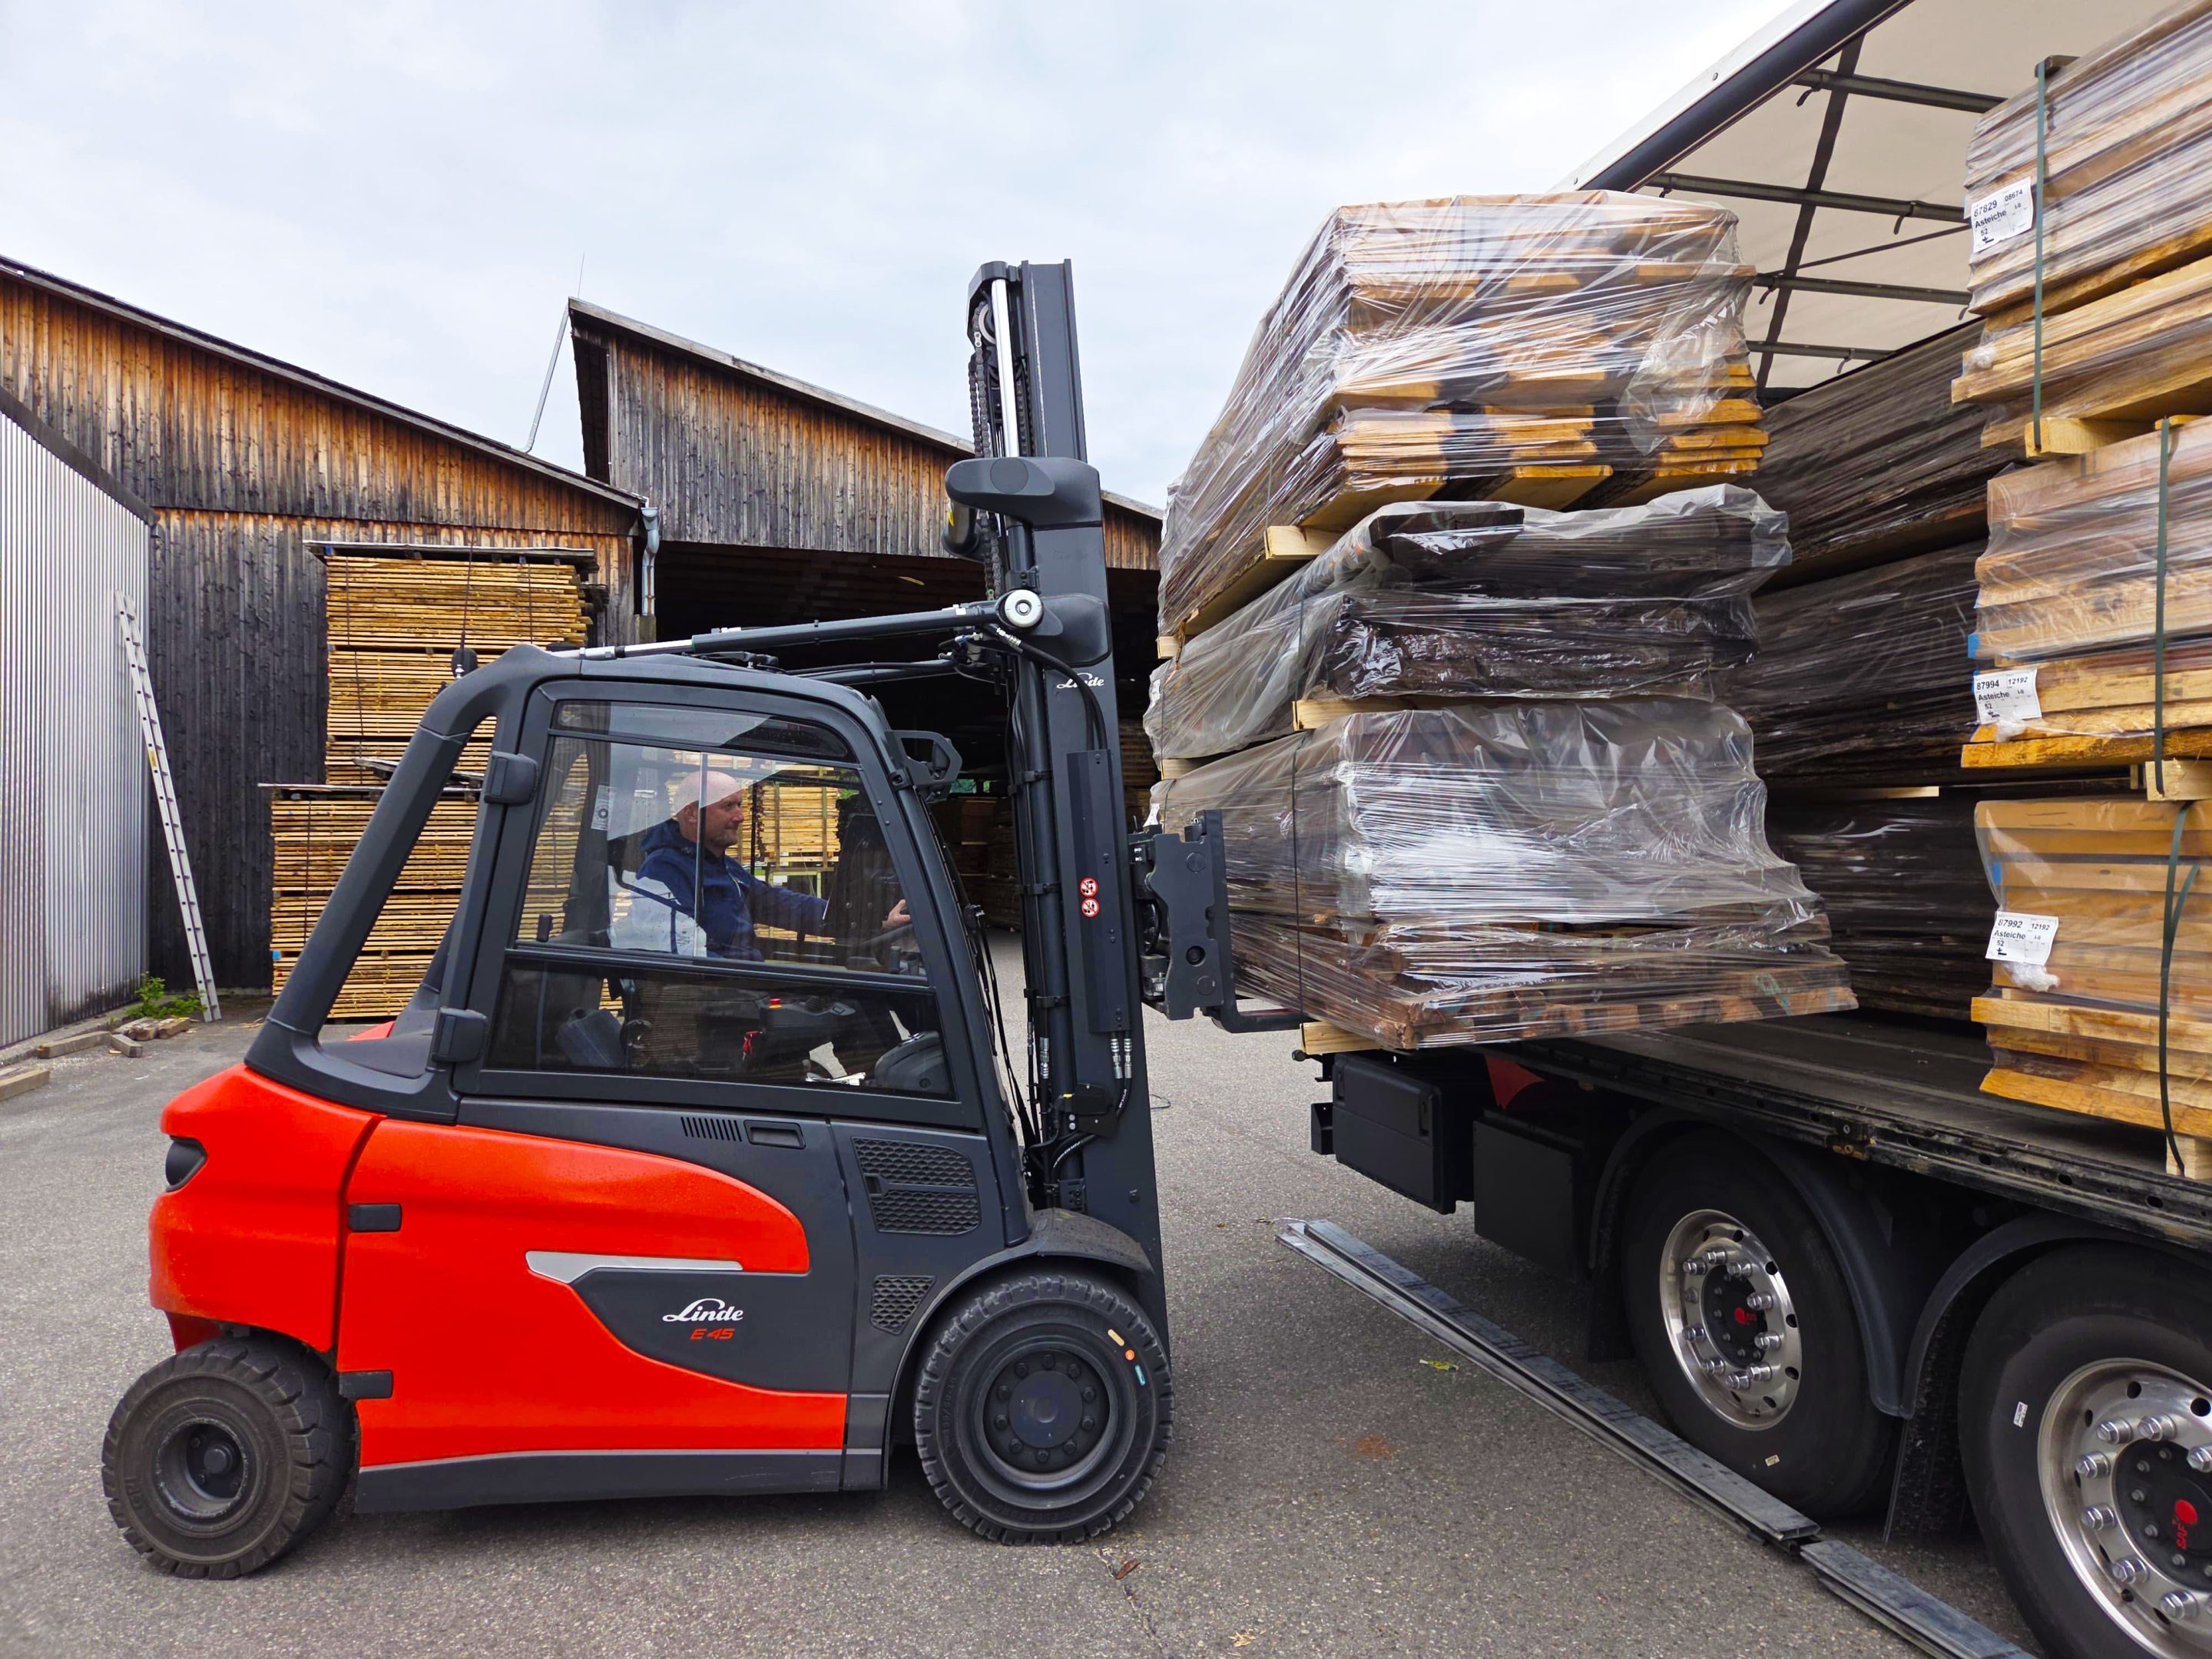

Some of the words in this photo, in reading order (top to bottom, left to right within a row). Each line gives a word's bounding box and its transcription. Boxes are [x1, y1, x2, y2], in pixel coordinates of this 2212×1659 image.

[1975, 210, 2007, 228] Asteiche
[1976, 680, 2000, 690] 87994
[2008, 677, 2028, 685] 12192
[1979, 691, 2010, 701] Asteiche
[1998, 919, 2023, 929] 87992
[1994, 930, 2025, 939] Asteiche
[662, 1298, 743, 1322] Linde
[690, 1328, 707, 1340] E
[707, 1328, 735, 1340] 45
[2176, 1525, 2187, 1550] SAF
